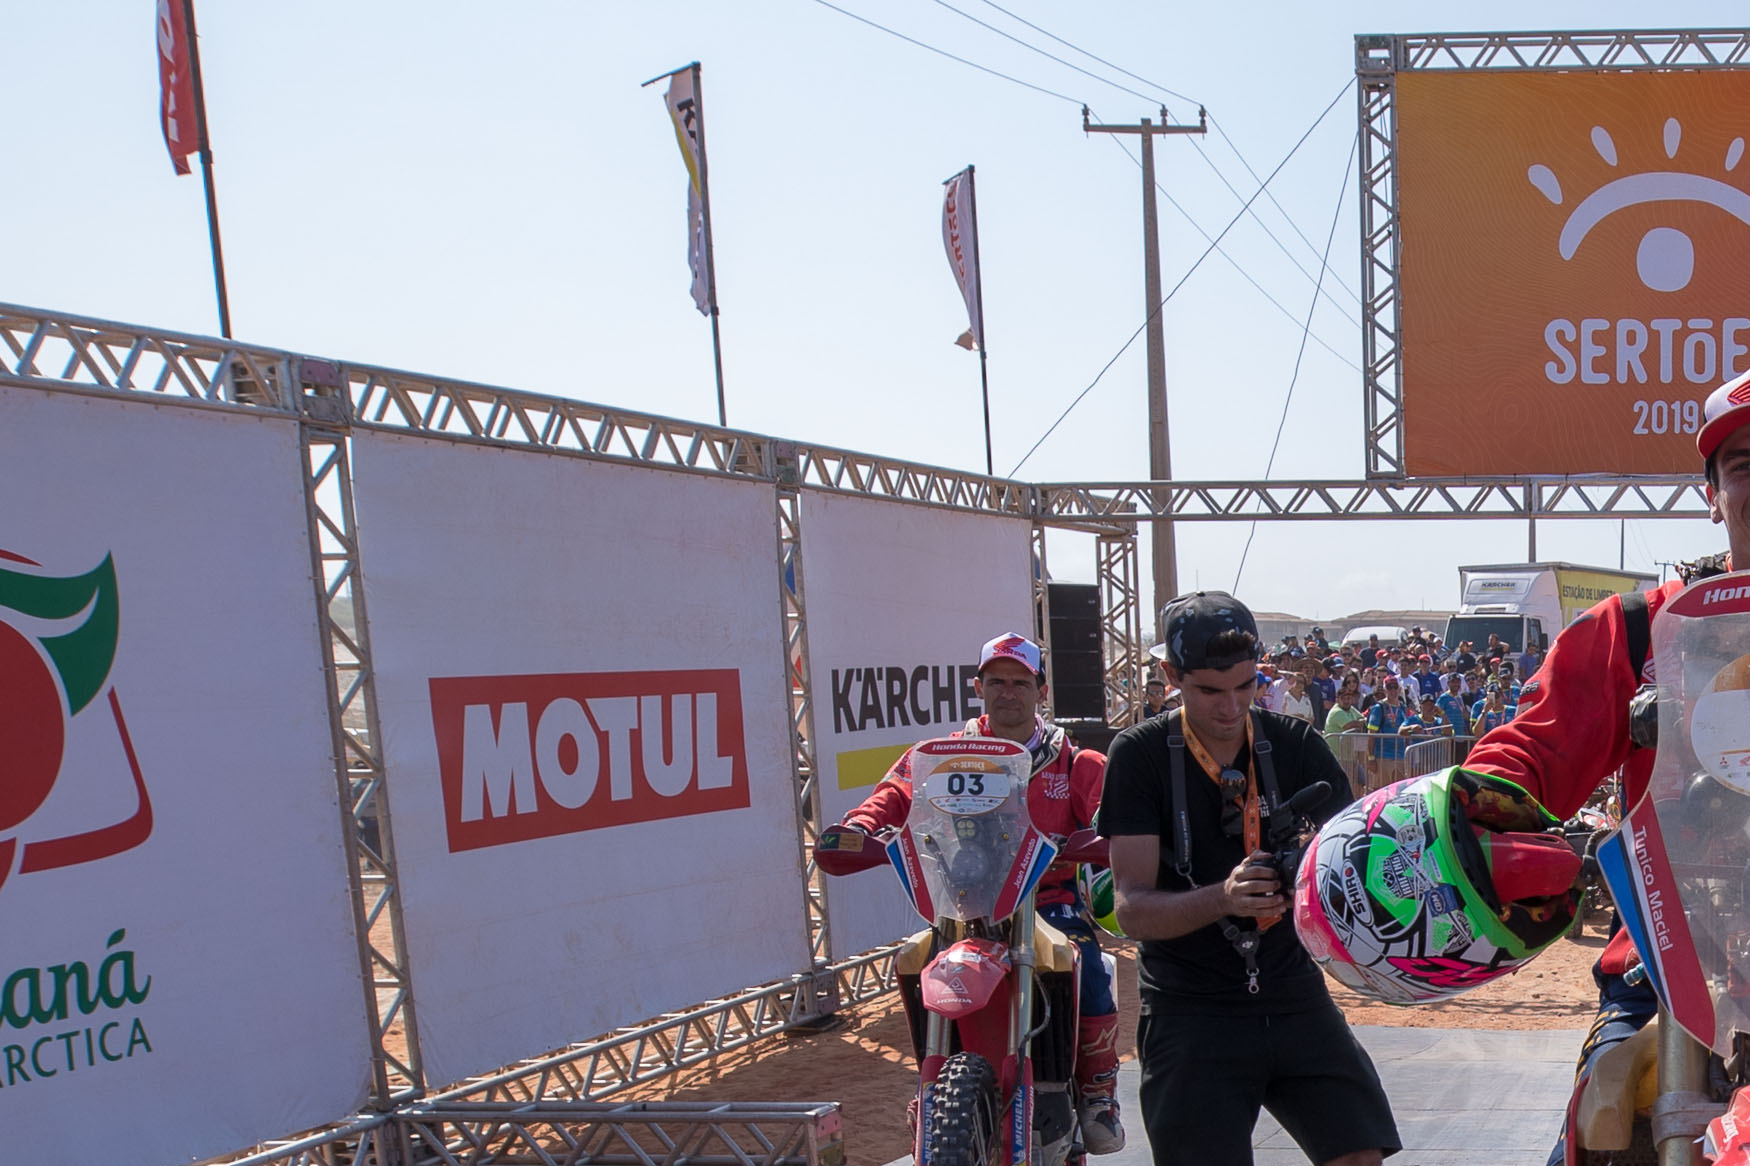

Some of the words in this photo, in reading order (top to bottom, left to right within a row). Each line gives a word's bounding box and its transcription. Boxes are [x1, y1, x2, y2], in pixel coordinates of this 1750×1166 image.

[1633, 400, 1699, 435] 2019
[831, 664, 985, 734] KÄRCHE
[461, 692, 734, 823] MOTUL
[932, 743, 965, 751] Honda
[967, 743, 1006, 753] Racing
[947, 773, 985, 796] 03
[1344, 866, 1367, 915] SHIRO
[1635, 825, 1655, 886] Tunico
[1648, 889, 1674, 952] Maciel
[0, 928, 152, 1029] aná
[0, 1018, 152, 1089] RCTICA
